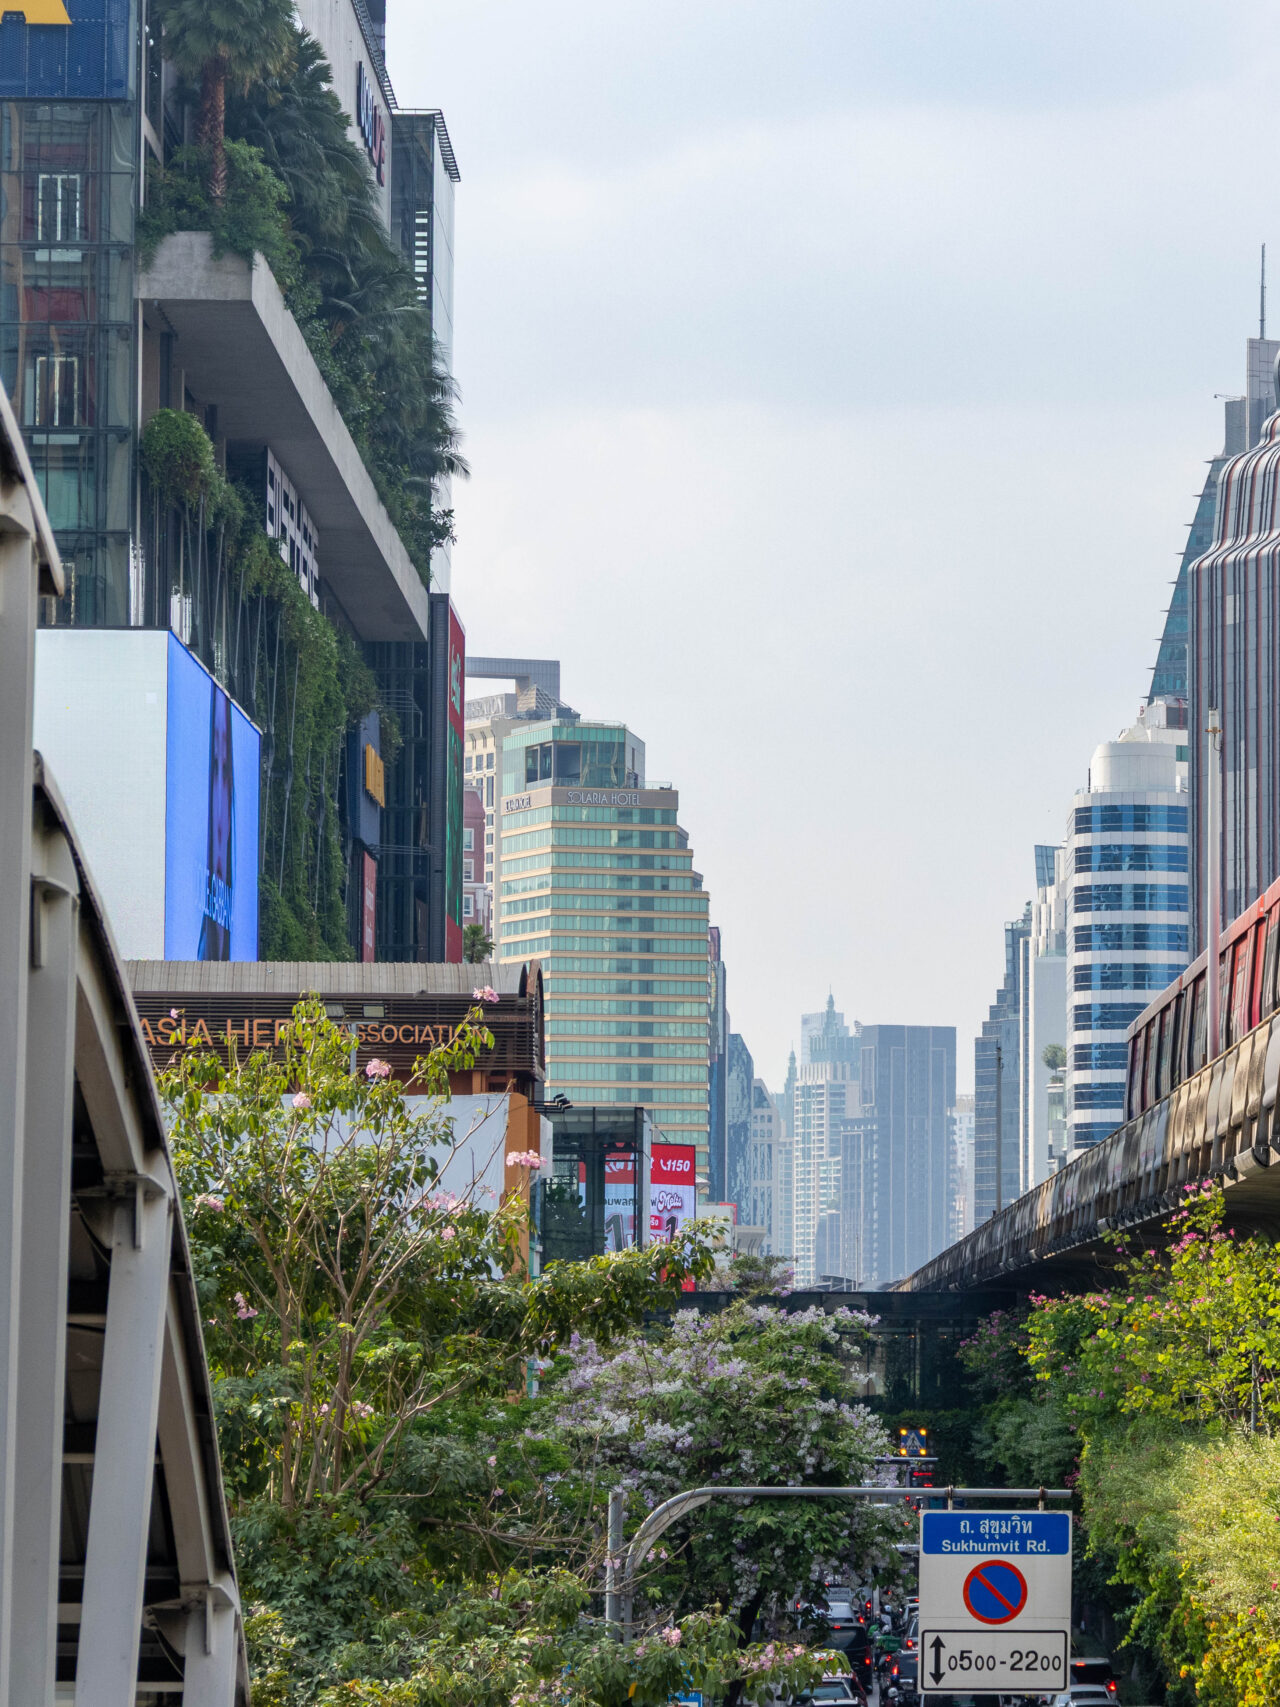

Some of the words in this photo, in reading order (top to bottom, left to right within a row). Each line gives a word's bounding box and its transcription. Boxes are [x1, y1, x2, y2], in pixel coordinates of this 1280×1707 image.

[567, 791, 608, 804] SOLARIA
[611, 793, 641, 805] HOTEL
[139, 1017, 214, 1047] ASIA
[667, 1160, 691, 1173] 1150
[960, 1520, 974, 1534] ถ.
[979, 1515, 1033, 1539] สุขุมวิท
[941, 1539, 1020, 1553] Sukhumvit
[1026, 1539, 1051, 1553] Rd.
